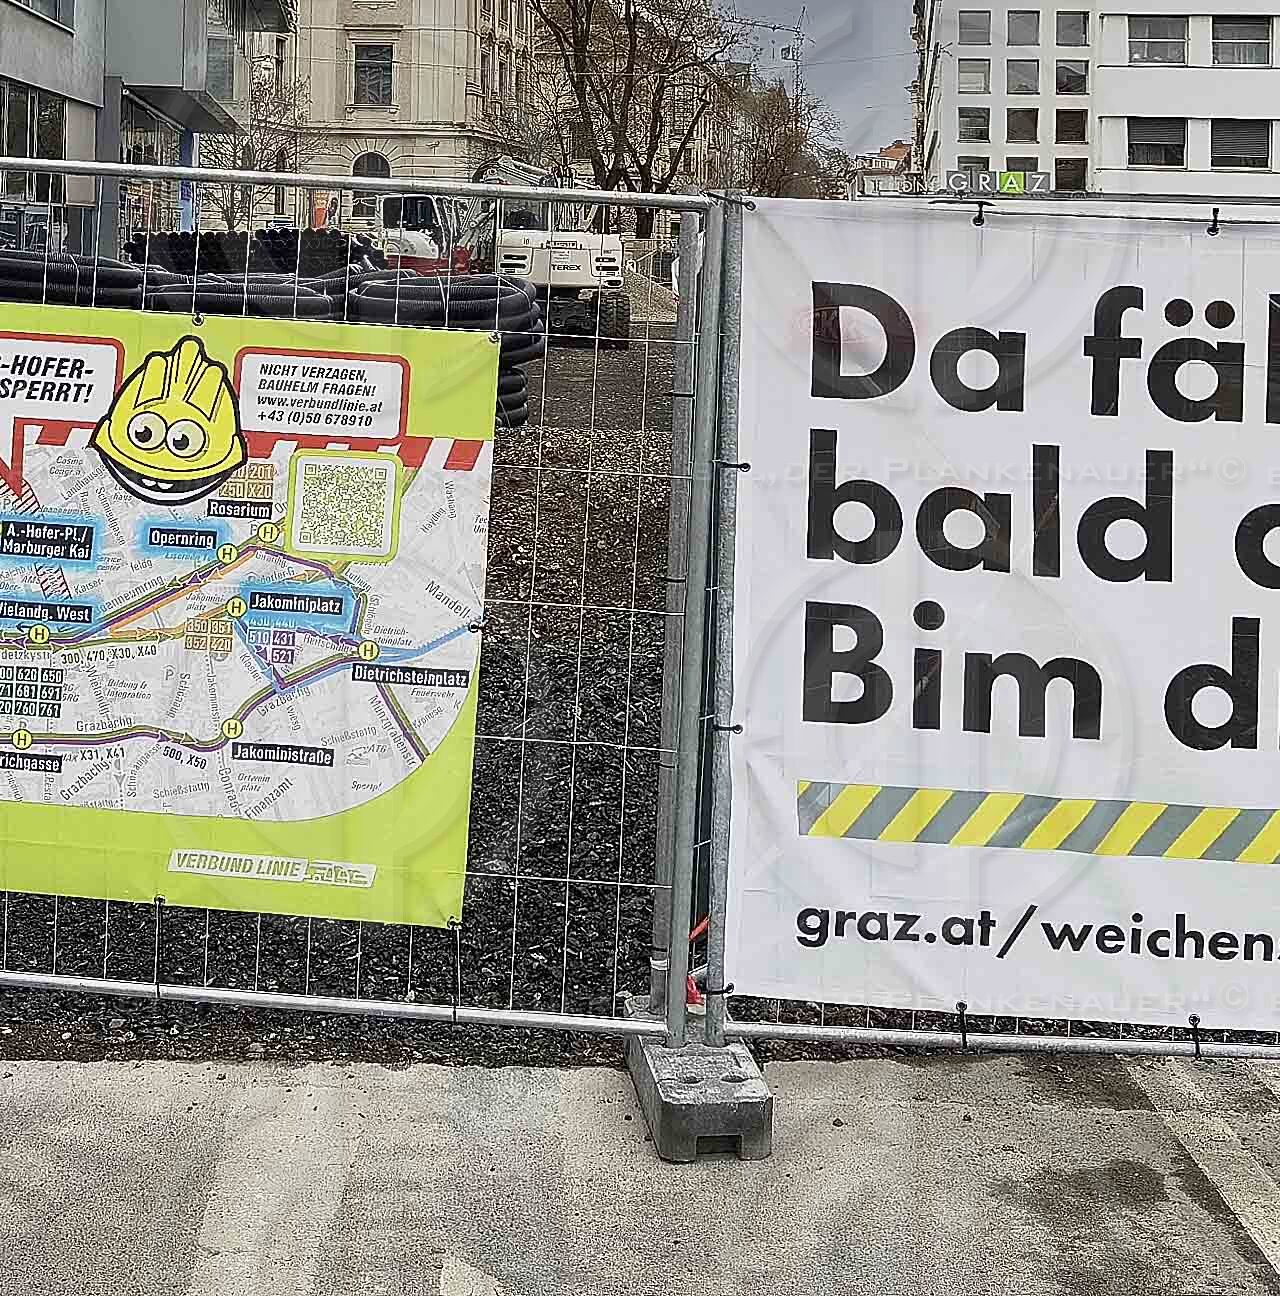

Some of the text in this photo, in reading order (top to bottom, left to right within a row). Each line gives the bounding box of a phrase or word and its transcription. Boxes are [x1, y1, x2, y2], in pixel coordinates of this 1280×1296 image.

[948, 172, 1050, 192] GRAZ
[811, 281, 1026, 412] Da
[259, 363, 368, 384] NICHT VERZAGEN,
[257, 380, 376, 398] BAUHELM FRAGEN!
[256, 394, 383, 415] www.verbundlinie.at
[256, 410, 373, 428] +43 (0)50 678910
[209, 502, 270, 518] Rosarium
[806, 429, 1174, 582] bald
[2, 539, 90, 560] Marburger Kai
[151, 530, 214, 550] Opernring
[58, 605, 89, 621] West
[251, 594, 341, 613] Jakominiplatz
[249, 629, 269, 644] 510
[17, 668, 38, 682] 620
[42, 669, 63, 683] 650
[354, 666, 467, 687] Dietrichsteinplatz
[802, 600, 1104, 740] Bim
[16, 685, 36, 699] 681
[40, 686, 61, 700] 691
[15, 702, 36, 716] 760
[39, 703, 60, 717] 761
[186, 754, 206, 769] X50
[234, 745, 332, 765] Jakoministraße
[176, 852, 254, 875] VERBUND
[256, 858, 302, 878] LINIE
